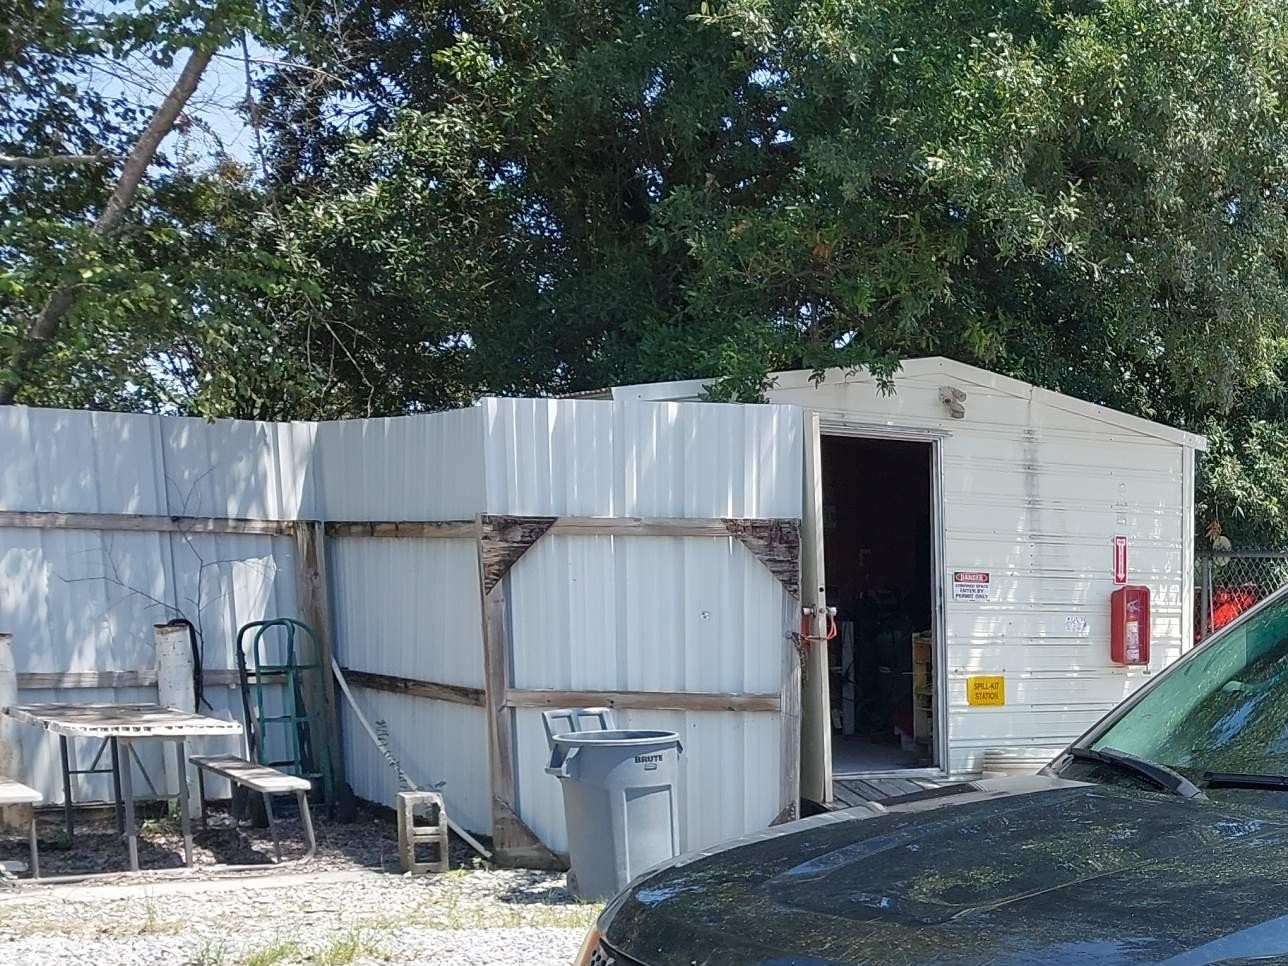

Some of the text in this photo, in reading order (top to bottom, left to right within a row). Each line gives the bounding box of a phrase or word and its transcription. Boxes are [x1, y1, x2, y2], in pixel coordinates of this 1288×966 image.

[974, 682, 999, 690] SPILL-KIT
[975, 692, 998, 700] STATION
[634, 754, 663, 764] BRUTE
